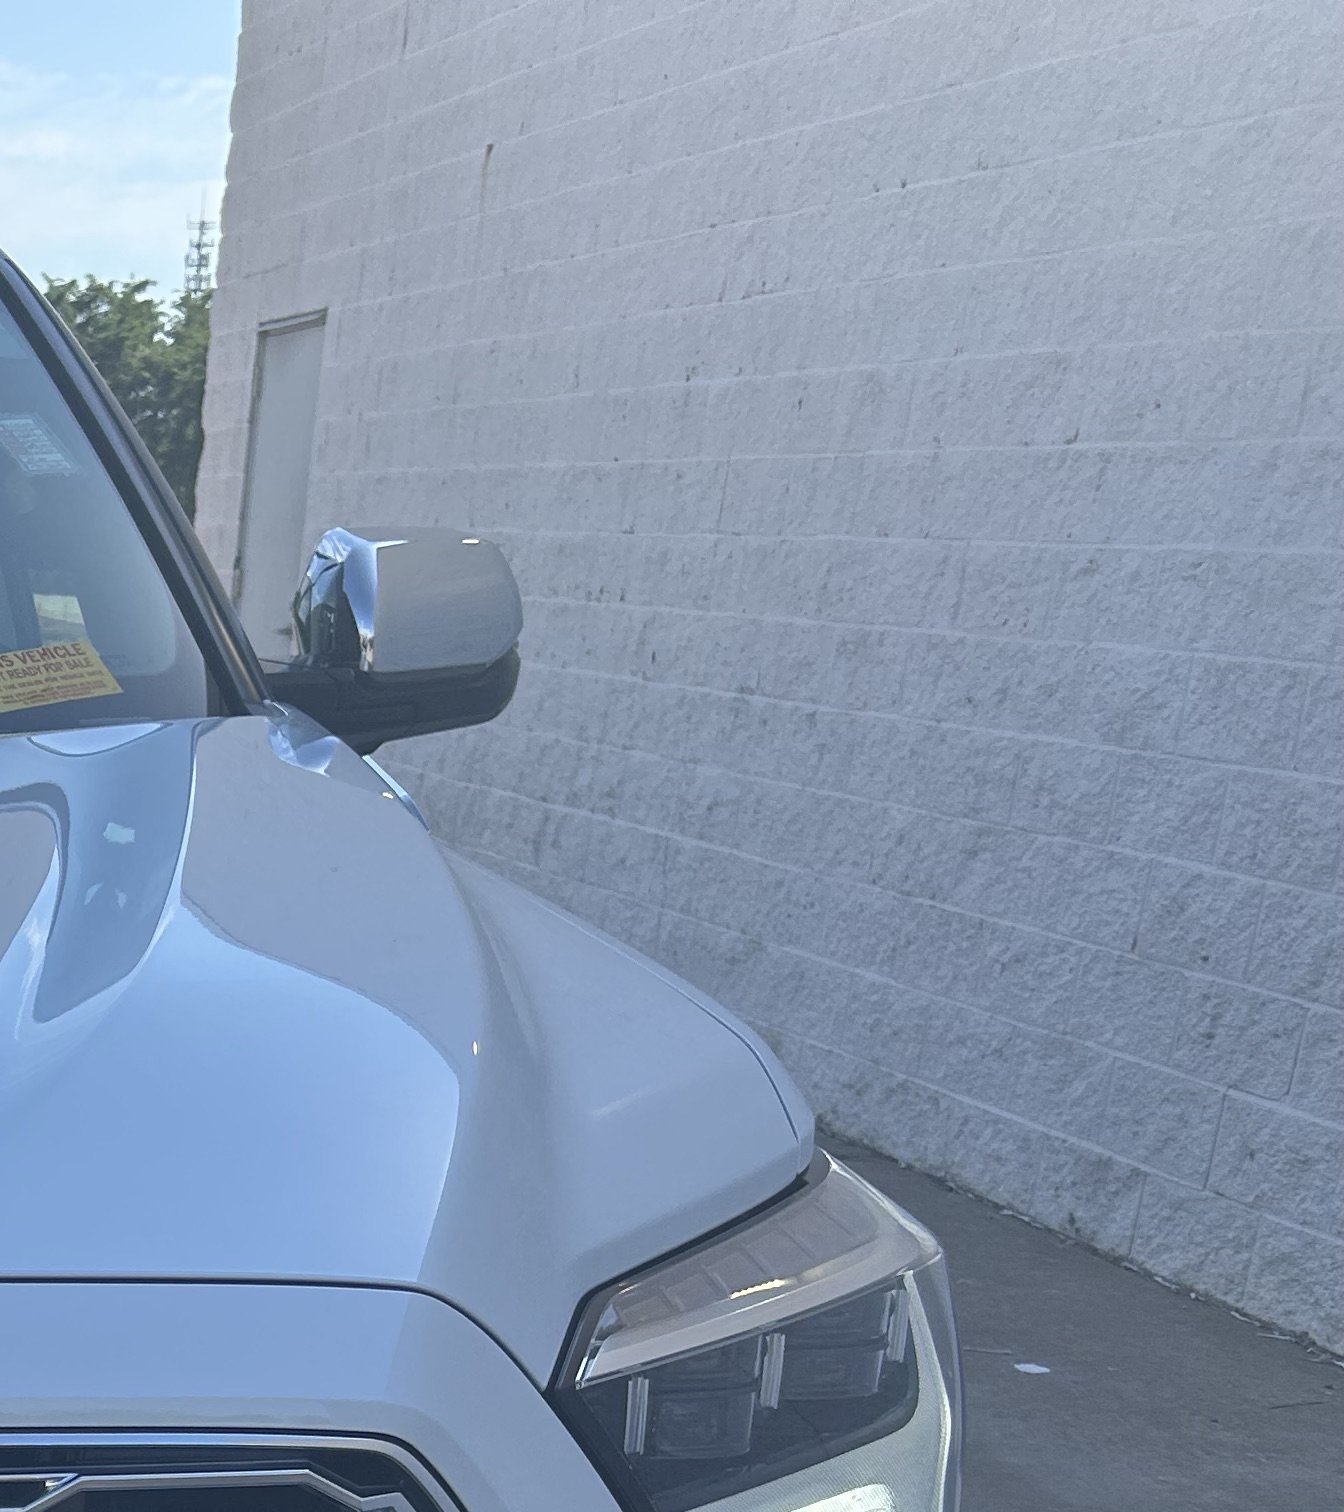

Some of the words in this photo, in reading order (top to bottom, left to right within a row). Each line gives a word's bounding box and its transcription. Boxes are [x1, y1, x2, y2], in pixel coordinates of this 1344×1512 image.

[13, 643, 86, 664] VEHICLE
[7, 664, 42, 680] READY
[42, 662, 66, 674] FOR
[65, 657, 94, 670] SALE
